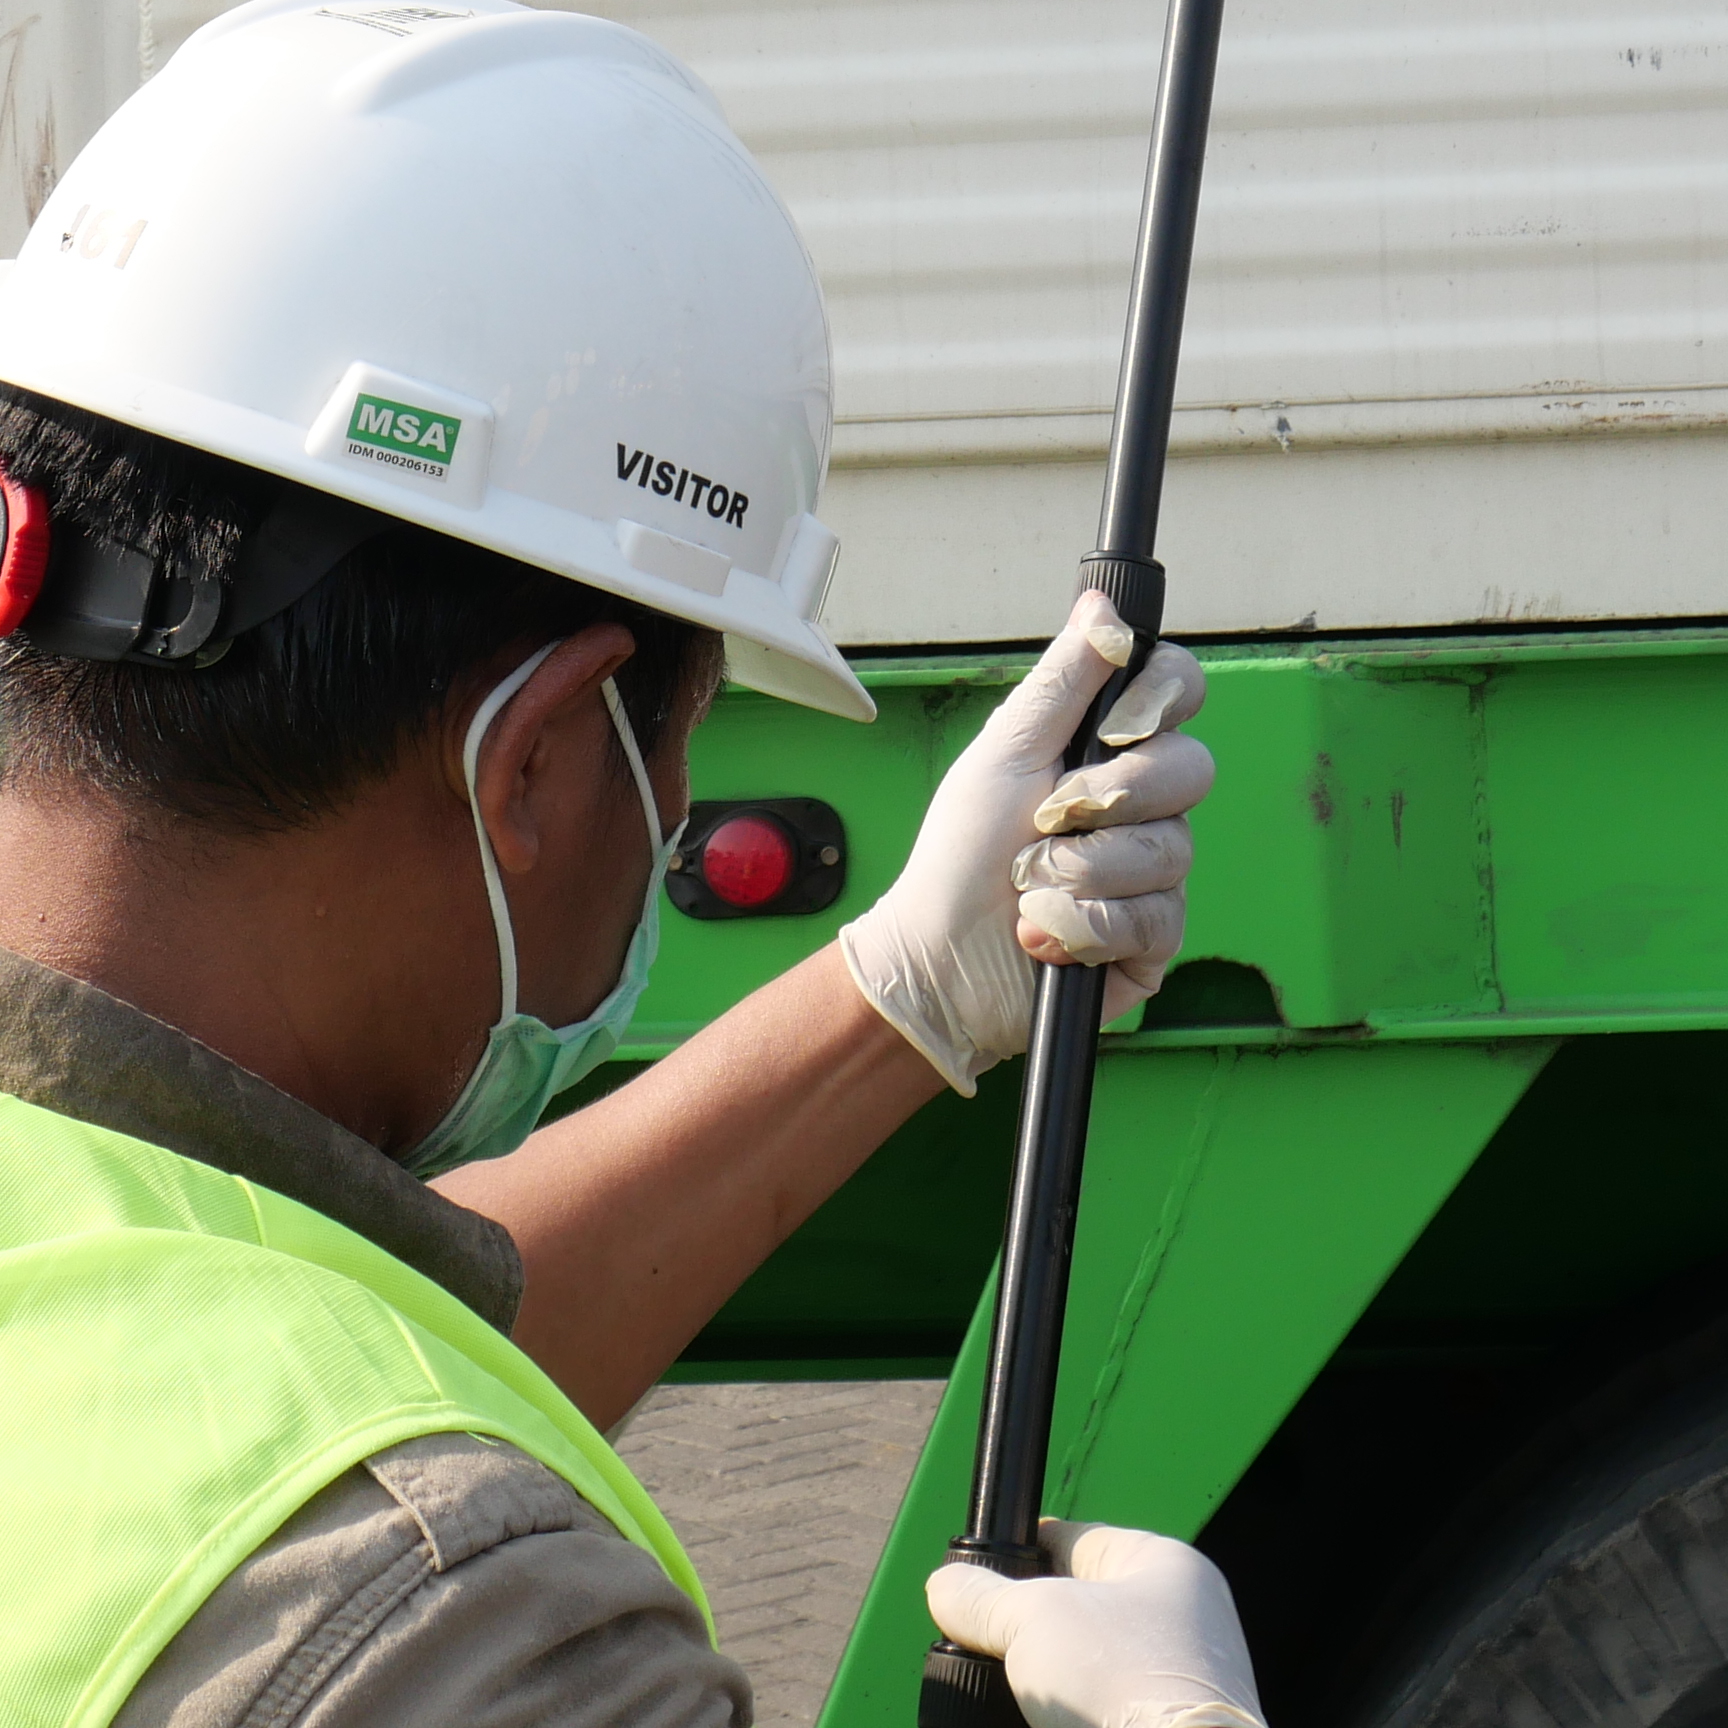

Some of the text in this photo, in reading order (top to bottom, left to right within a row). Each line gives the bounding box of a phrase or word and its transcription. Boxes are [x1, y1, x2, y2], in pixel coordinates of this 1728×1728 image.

[357, 402, 447, 454] MSA
[348, 443, 444, 477] IDM 000206153
[617, 442, 749, 529] VISITOR
